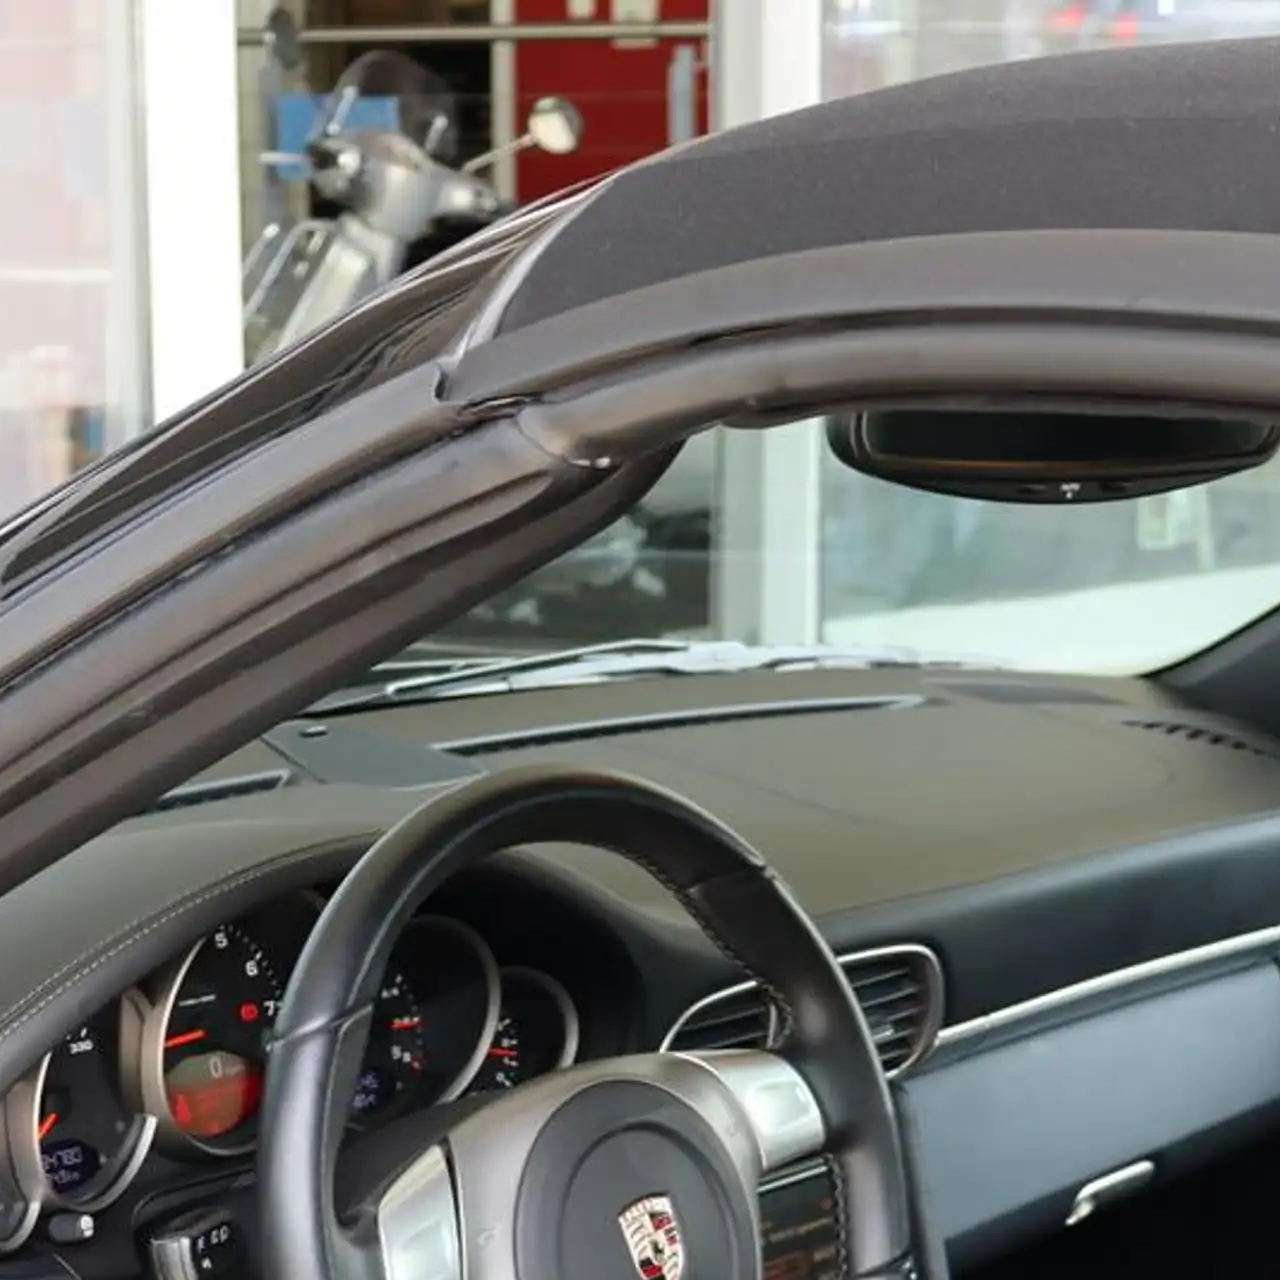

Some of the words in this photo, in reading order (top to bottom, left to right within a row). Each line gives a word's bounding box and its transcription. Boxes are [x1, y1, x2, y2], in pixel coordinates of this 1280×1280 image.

[214, 932, 228, 949] 5
[245, 959, 259, 977] 6
[263, 1000, 275, 1016] 7
[208, 1054, 222, 1079] 0
